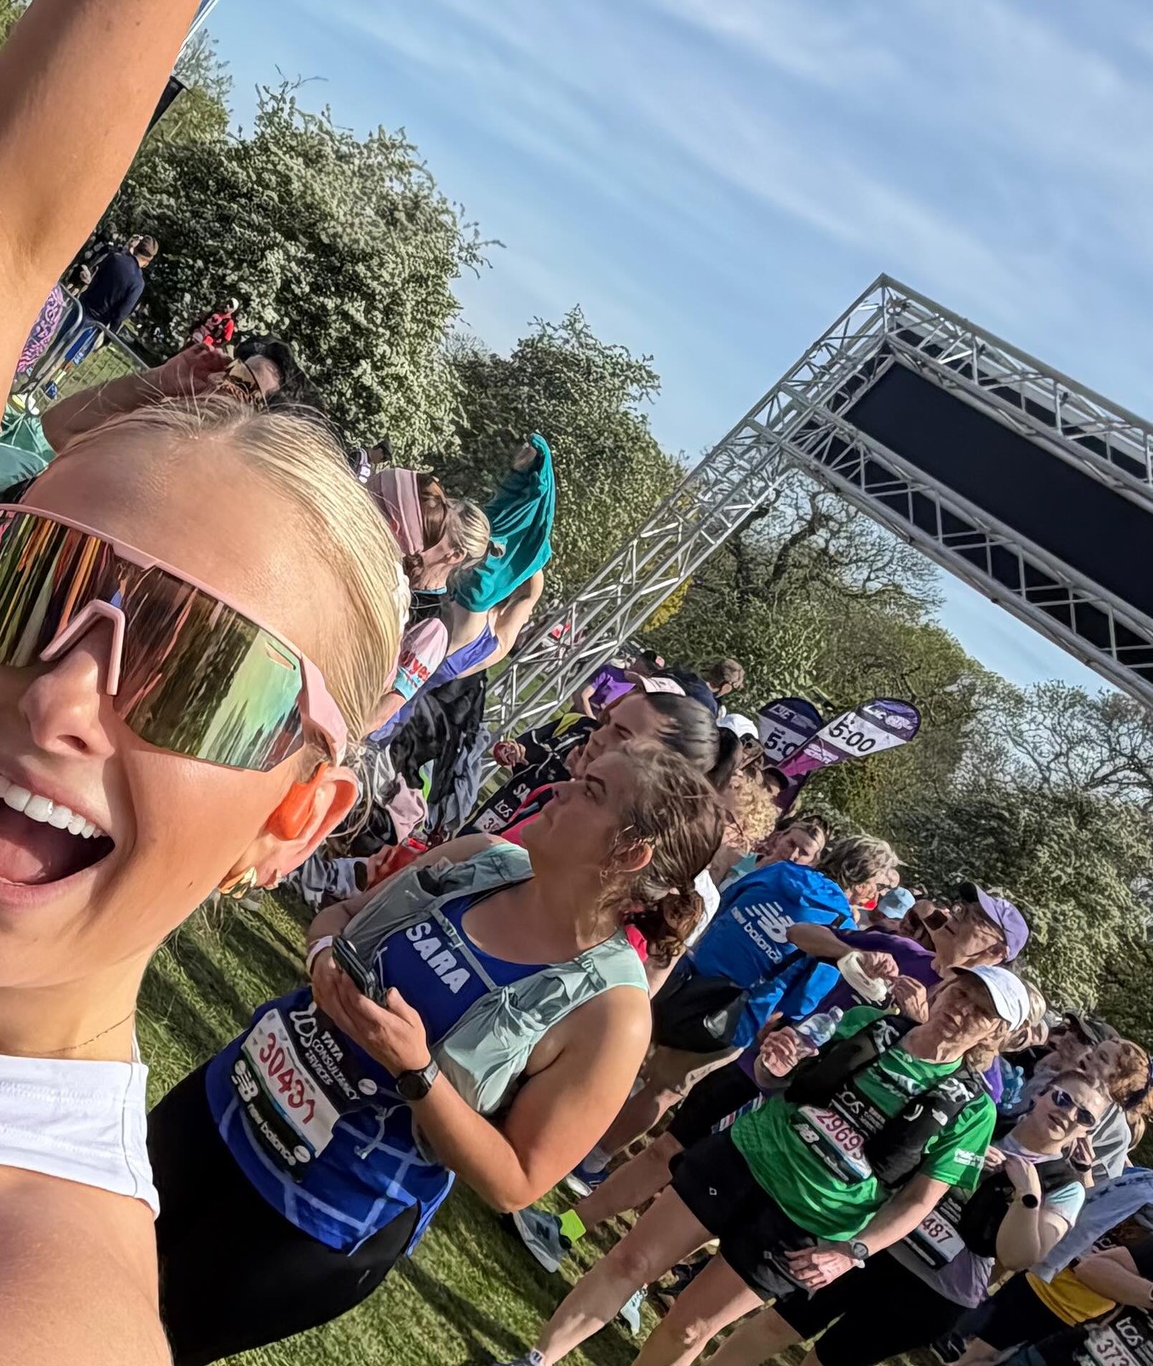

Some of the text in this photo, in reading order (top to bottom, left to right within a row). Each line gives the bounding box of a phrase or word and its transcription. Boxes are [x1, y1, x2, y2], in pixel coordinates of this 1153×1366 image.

[828, 721, 876, 753] 5:00
[405, 922, 471, 994] SARA
[321, 1031, 344, 1063] TATA
